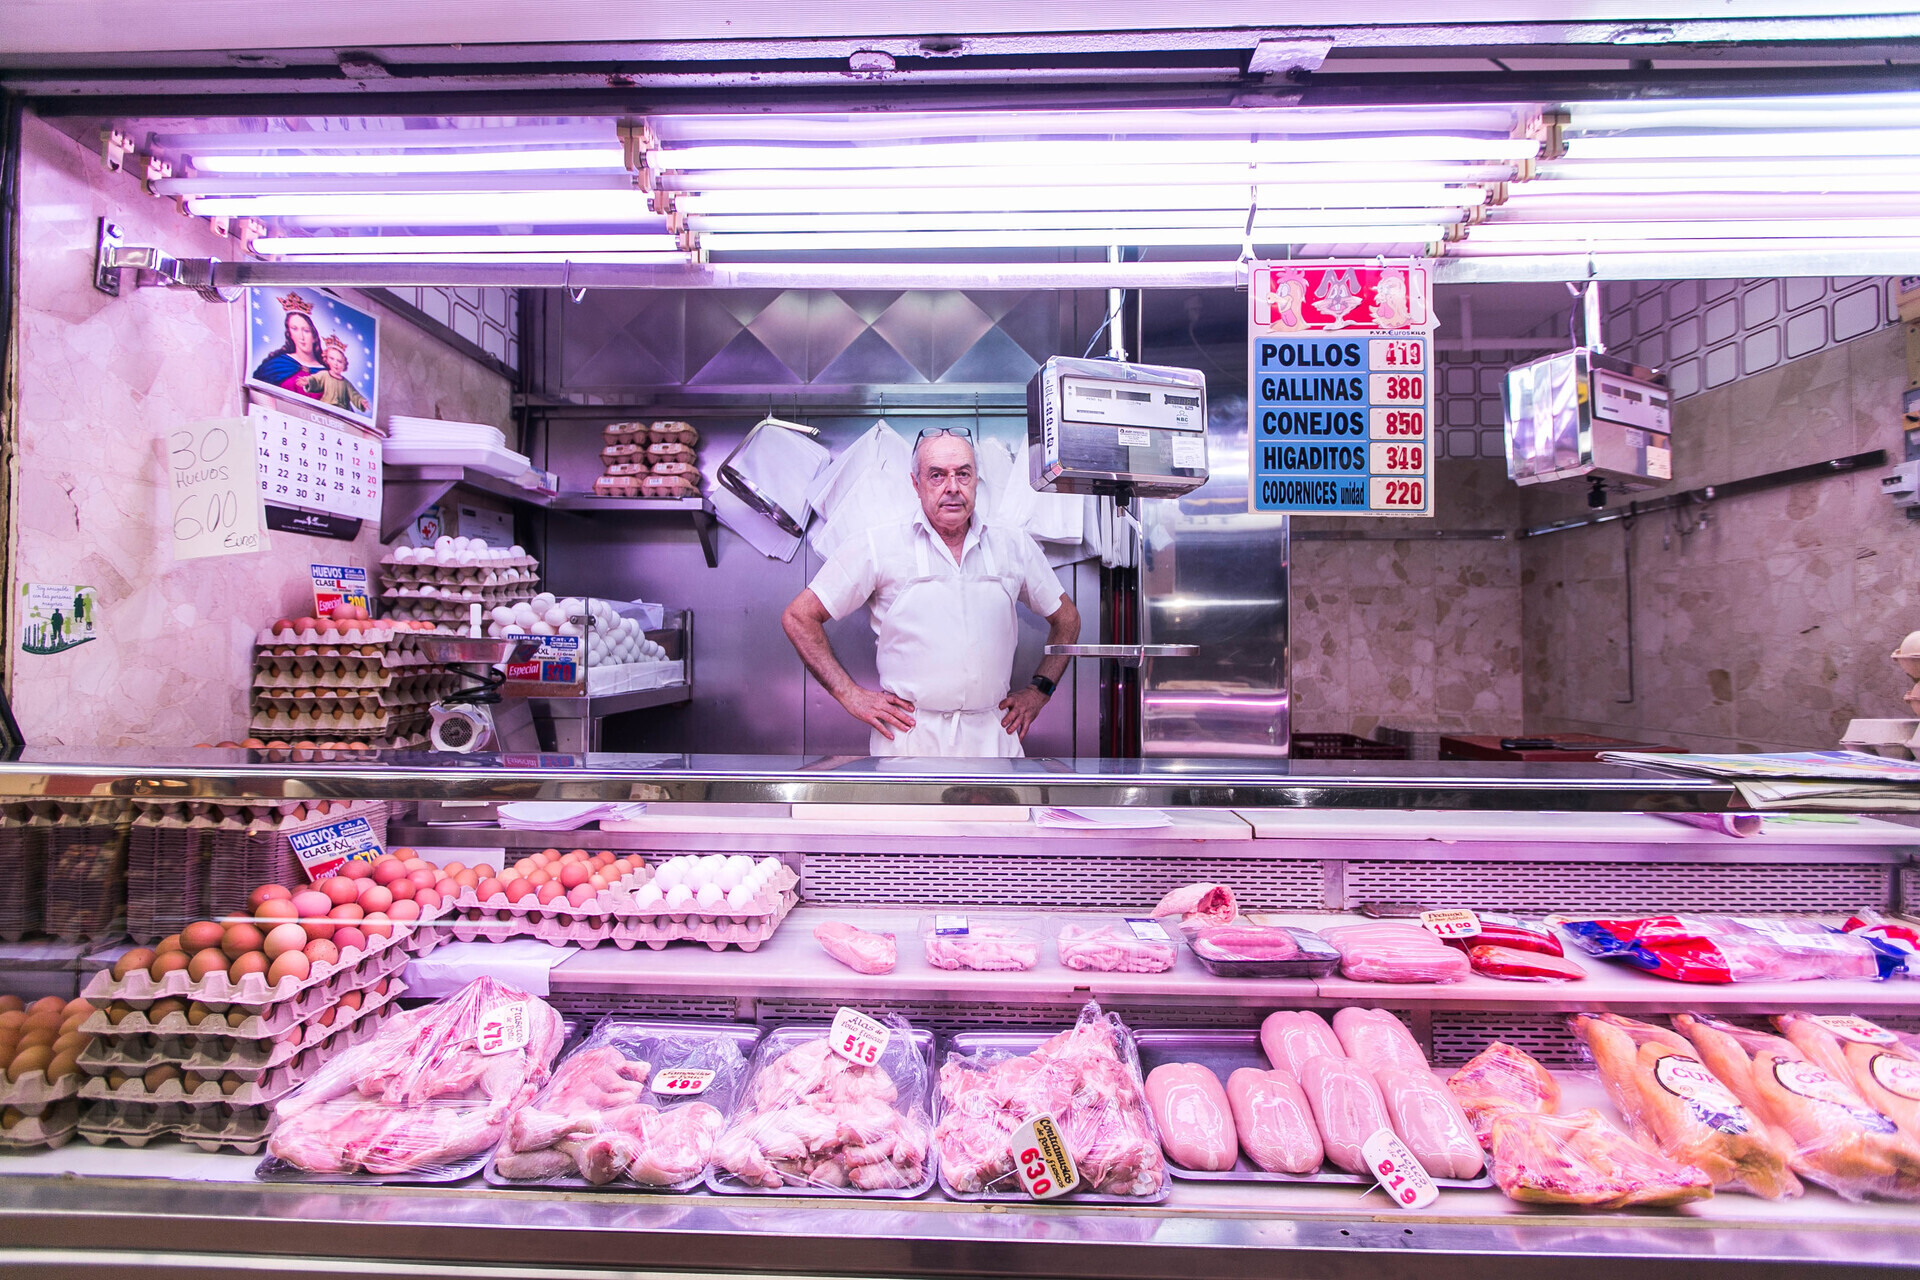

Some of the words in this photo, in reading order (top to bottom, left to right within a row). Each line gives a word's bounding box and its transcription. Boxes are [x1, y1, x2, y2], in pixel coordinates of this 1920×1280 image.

[1261, 343, 1361, 367] POLLOS
[1261, 377, 1364, 401] GALLINAS
[1262, 411, 1364, 435] CONEJOS
[171, 427, 229, 470] 30
[283, 421, 287, 430] 1
[301, 427, 307, 436] 2
[320, 432, 325, 441] 3
[337, 438, 342, 446] 4
[354, 442, 359, 451] 5
[369, 448, 374, 456] 6
[262, 431, 267, 440] 7
[281, 437, 288, 446] 8
[301, 442, 306, 451] 9
[318, 447, 328, 457] 10
[335, 452, 343, 461] 11
[352, 457, 360, 466] 12
[368, 461, 376, 471] 13
[1263, 446, 1365, 470] HIGADITOS
[176, 465, 229, 488] HUEVOS
[259, 447, 270, 458] 14
[280, 452, 289, 463] 15
[298, 457, 308, 467] 16
[318, 462, 327, 471] 17
[335, 467, 344, 476] 18
[352, 471, 361, 480] 19
[367, 475, 376, 485] 20
[261, 481, 268, 490] 8
[276, 484, 288, 494] 29
[295, 488, 307, 498] 30
[314, 492, 325, 502] 31
[277, 468, 289, 478] 22
[297, 473, 308, 483] 23
[315, 477, 327, 487] 24
[333, 481, 344, 491] 25
[350, 485, 361, 495] 26
[367, 490, 376, 499] 27
[1262, 480, 1337, 505] CODORNICES
[1340, 482, 1365, 505] unidad
[223, 532, 258, 548] Euros
[312, 565, 343, 579] HUEVOS
[315, 579, 335, 587] CLASE
[336, 579, 347, 589] L
[36, 584, 46, 594] Soy
[46, 585, 69, 593] amigable
[509, 664, 539, 676] Especial
[291, 827, 338, 849] HUEVOS
[338, 822, 356, 830] Cat.
[302, 844, 333, 859] CLASE
[332, 838, 352, 851] XXL
[848, 1016, 874, 1031] Alas
[1036, 1127, 1044, 1136] de
[1038, 1136, 1052, 1157] Pollo
[1039, 1119, 1074, 1184] Contramuslos
[1387, 1149, 1397, 1158] de
[1398, 1163, 1422, 1188] Pollo
[1389, 1139, 1427, 1185] Filetes
